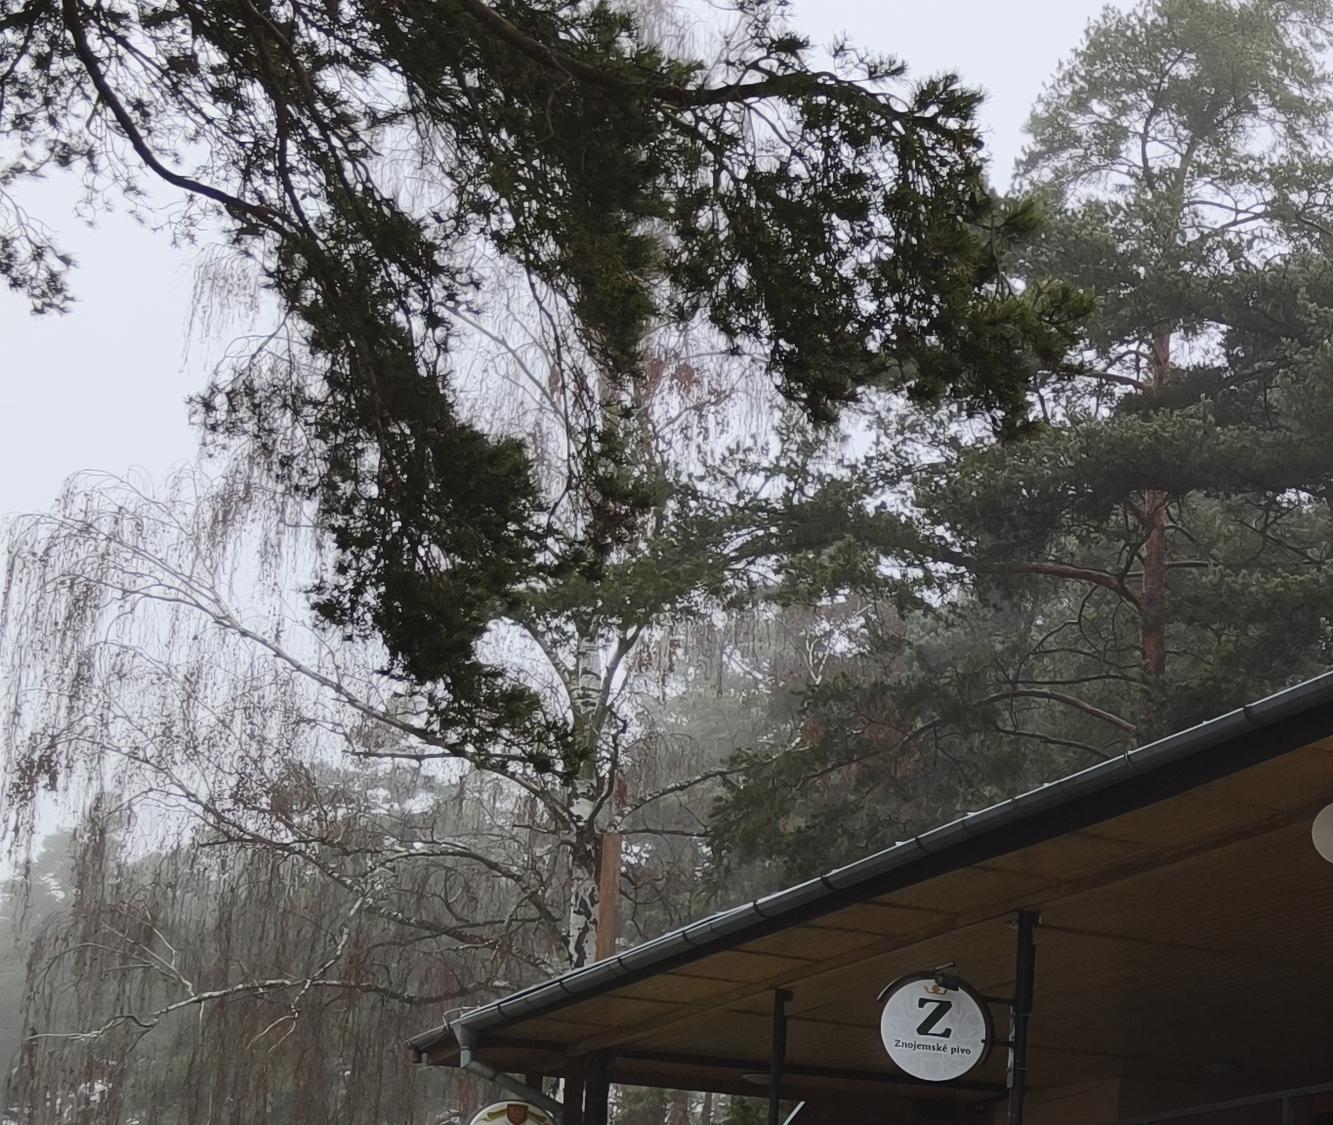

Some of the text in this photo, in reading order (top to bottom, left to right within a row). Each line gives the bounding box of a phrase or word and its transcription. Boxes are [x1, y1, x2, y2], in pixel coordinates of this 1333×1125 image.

[916, 997, 953, 1039] Z
[894, 1039, 972, 1055] Znojemské pivo
